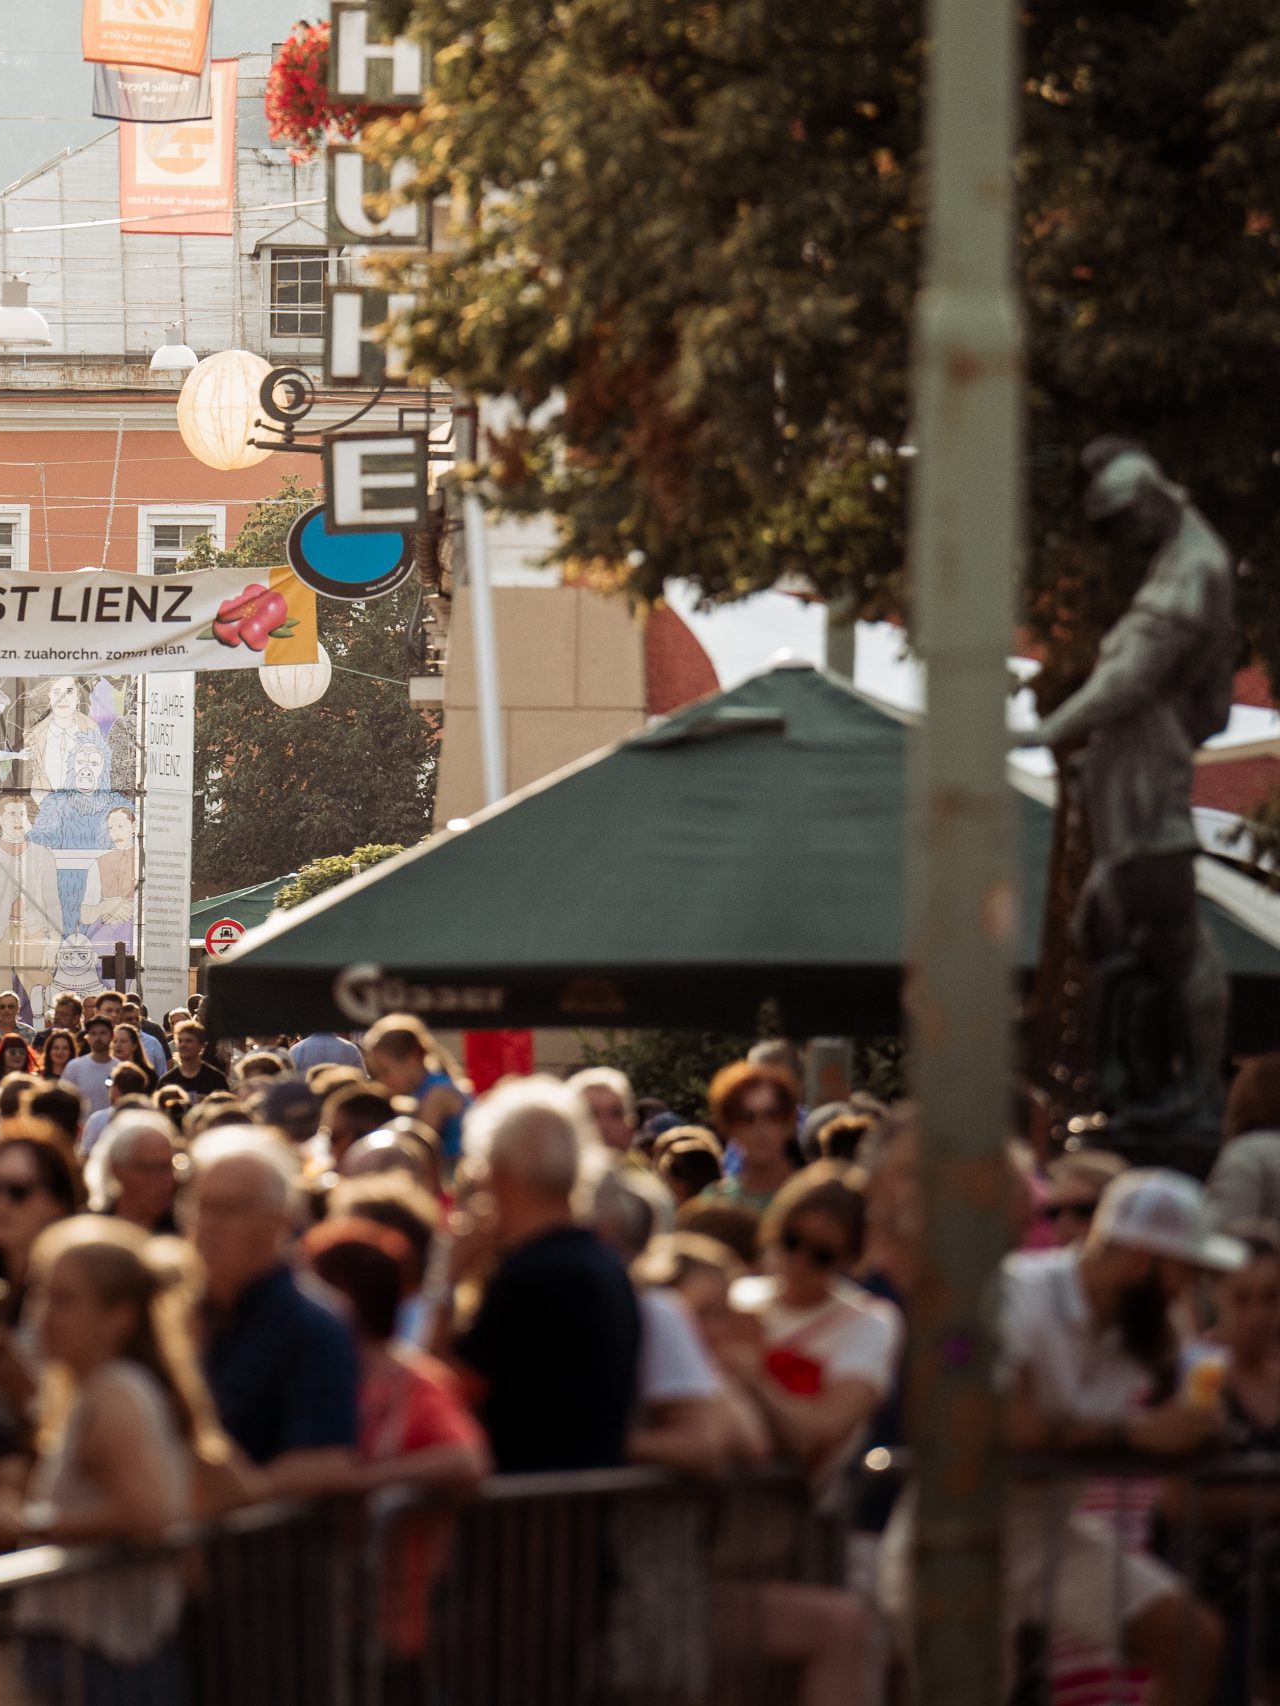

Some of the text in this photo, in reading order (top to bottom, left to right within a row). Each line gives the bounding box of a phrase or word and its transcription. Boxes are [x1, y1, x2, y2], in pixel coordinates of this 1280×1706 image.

[50, 585, 193, 622] LIENZ
[23, 646, 102, 660] zuahorchn.
[159, 693, 185, 717] JAHRE
[150, 722, 175, 746] DURST
[149, 752, 181, 777] IN LIENZ
